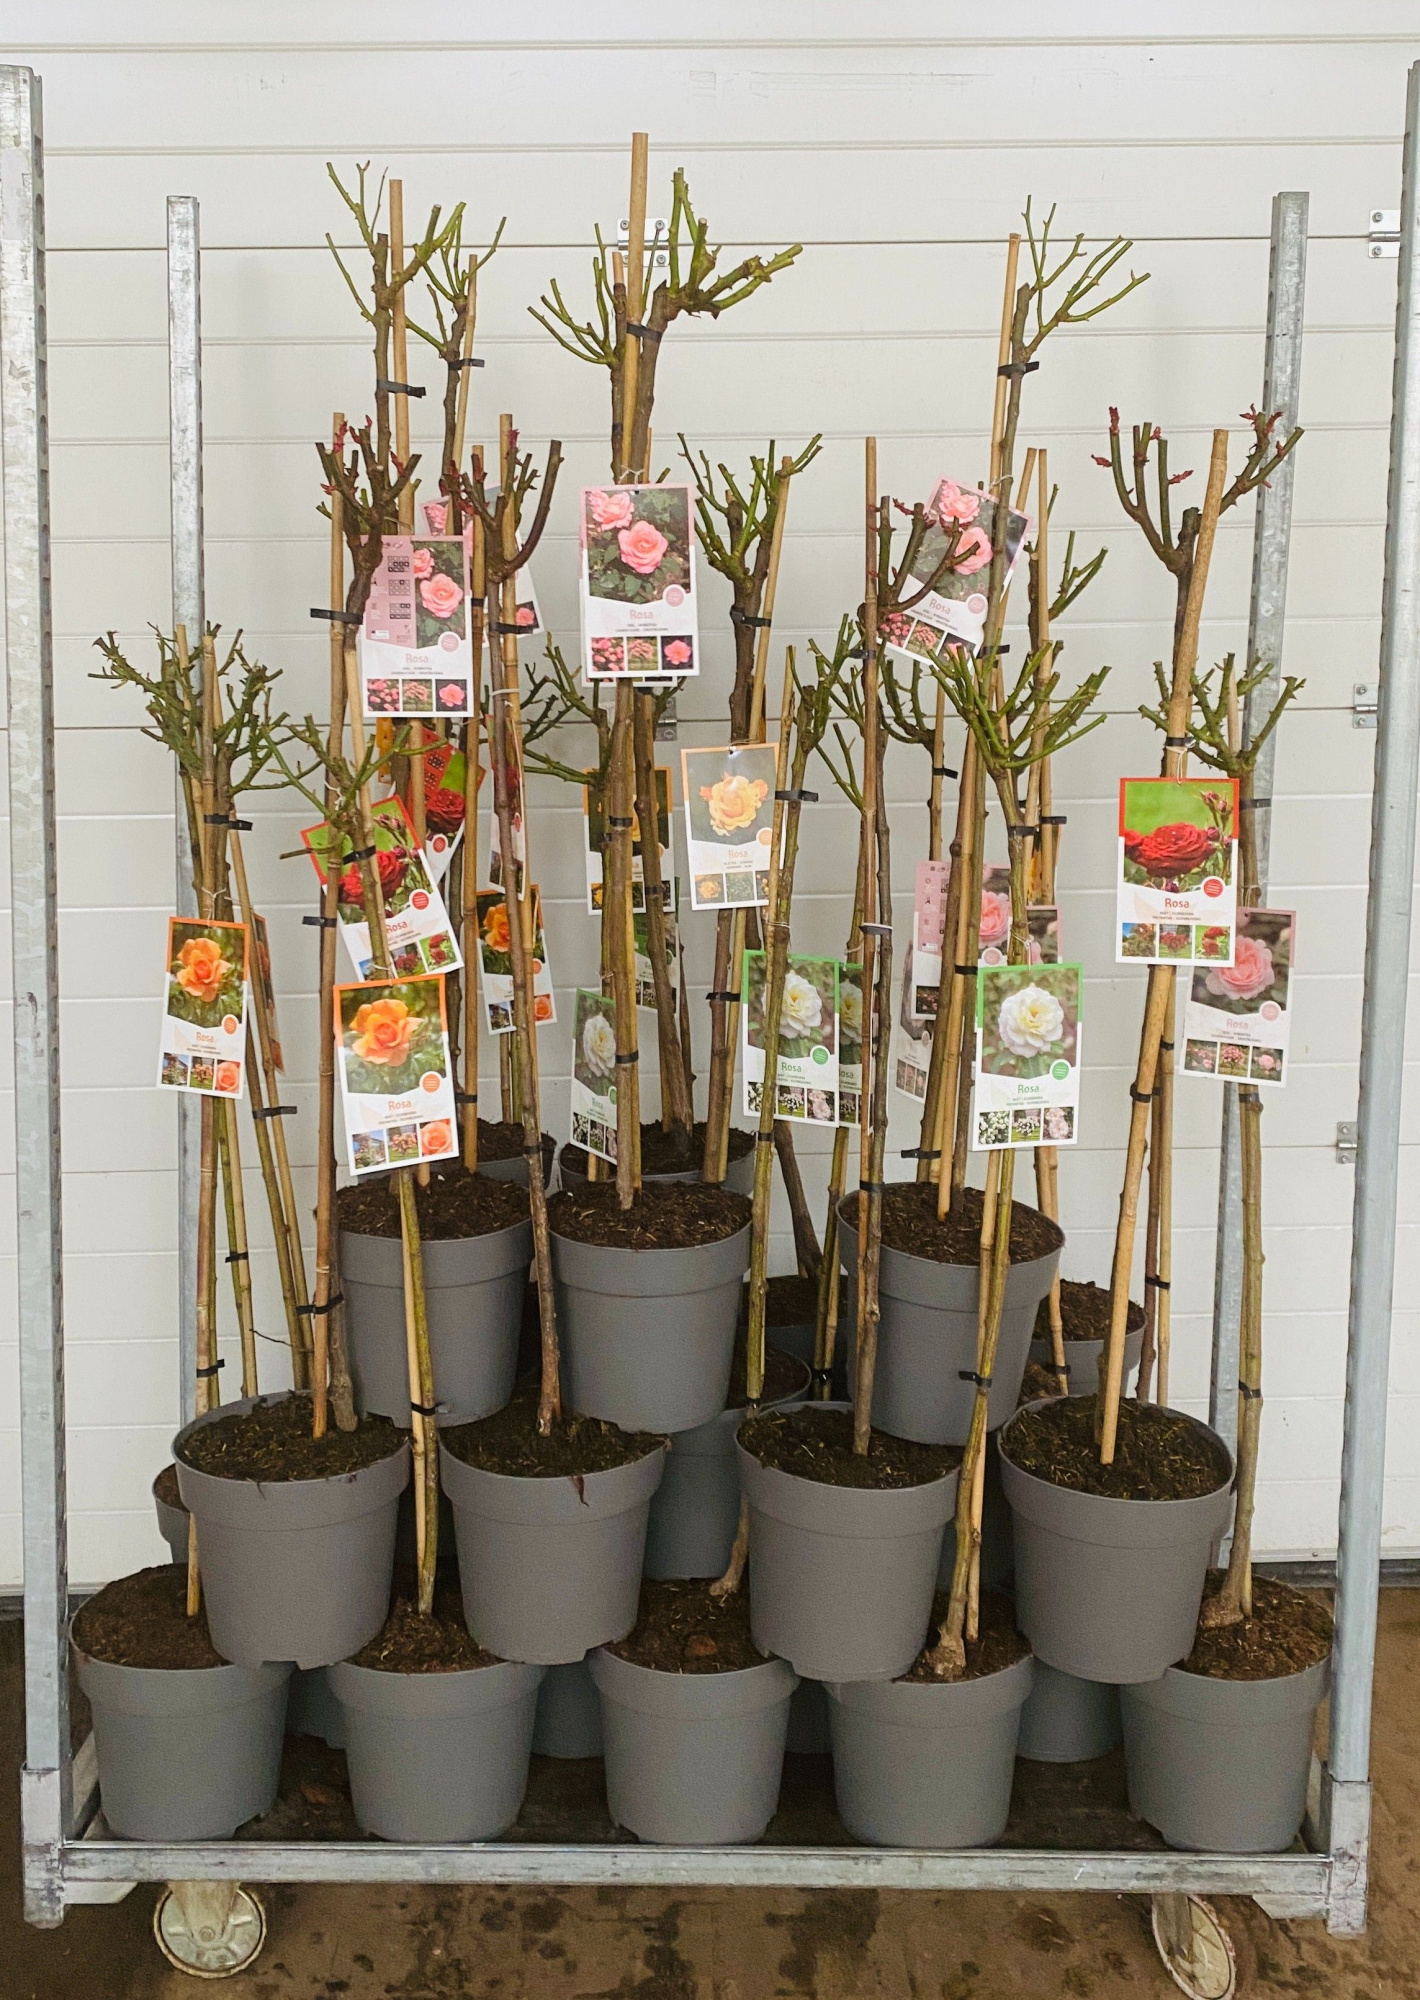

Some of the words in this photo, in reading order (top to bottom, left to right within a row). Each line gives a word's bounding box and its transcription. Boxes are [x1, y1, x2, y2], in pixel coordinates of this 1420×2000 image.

[929, 598, 951, 615] Rosa
[629, 609, 654, 619] Rosa
[405, 653, 429, 663] Rosa
[728, 849, 748, 858] Rosa
[1164, 897, 1190, 908] Rosa
[1226, 1018, 1249, 1029] Rosa
[196, 1031, 214, 1043] Rosa
[781, 1061, 802, 1073] Rosa
[840, 1070, 854, 1079] osa
[1017, 1084, 1040, 1094] Rosa
[387, 1100, 412, 1111] Rosa
